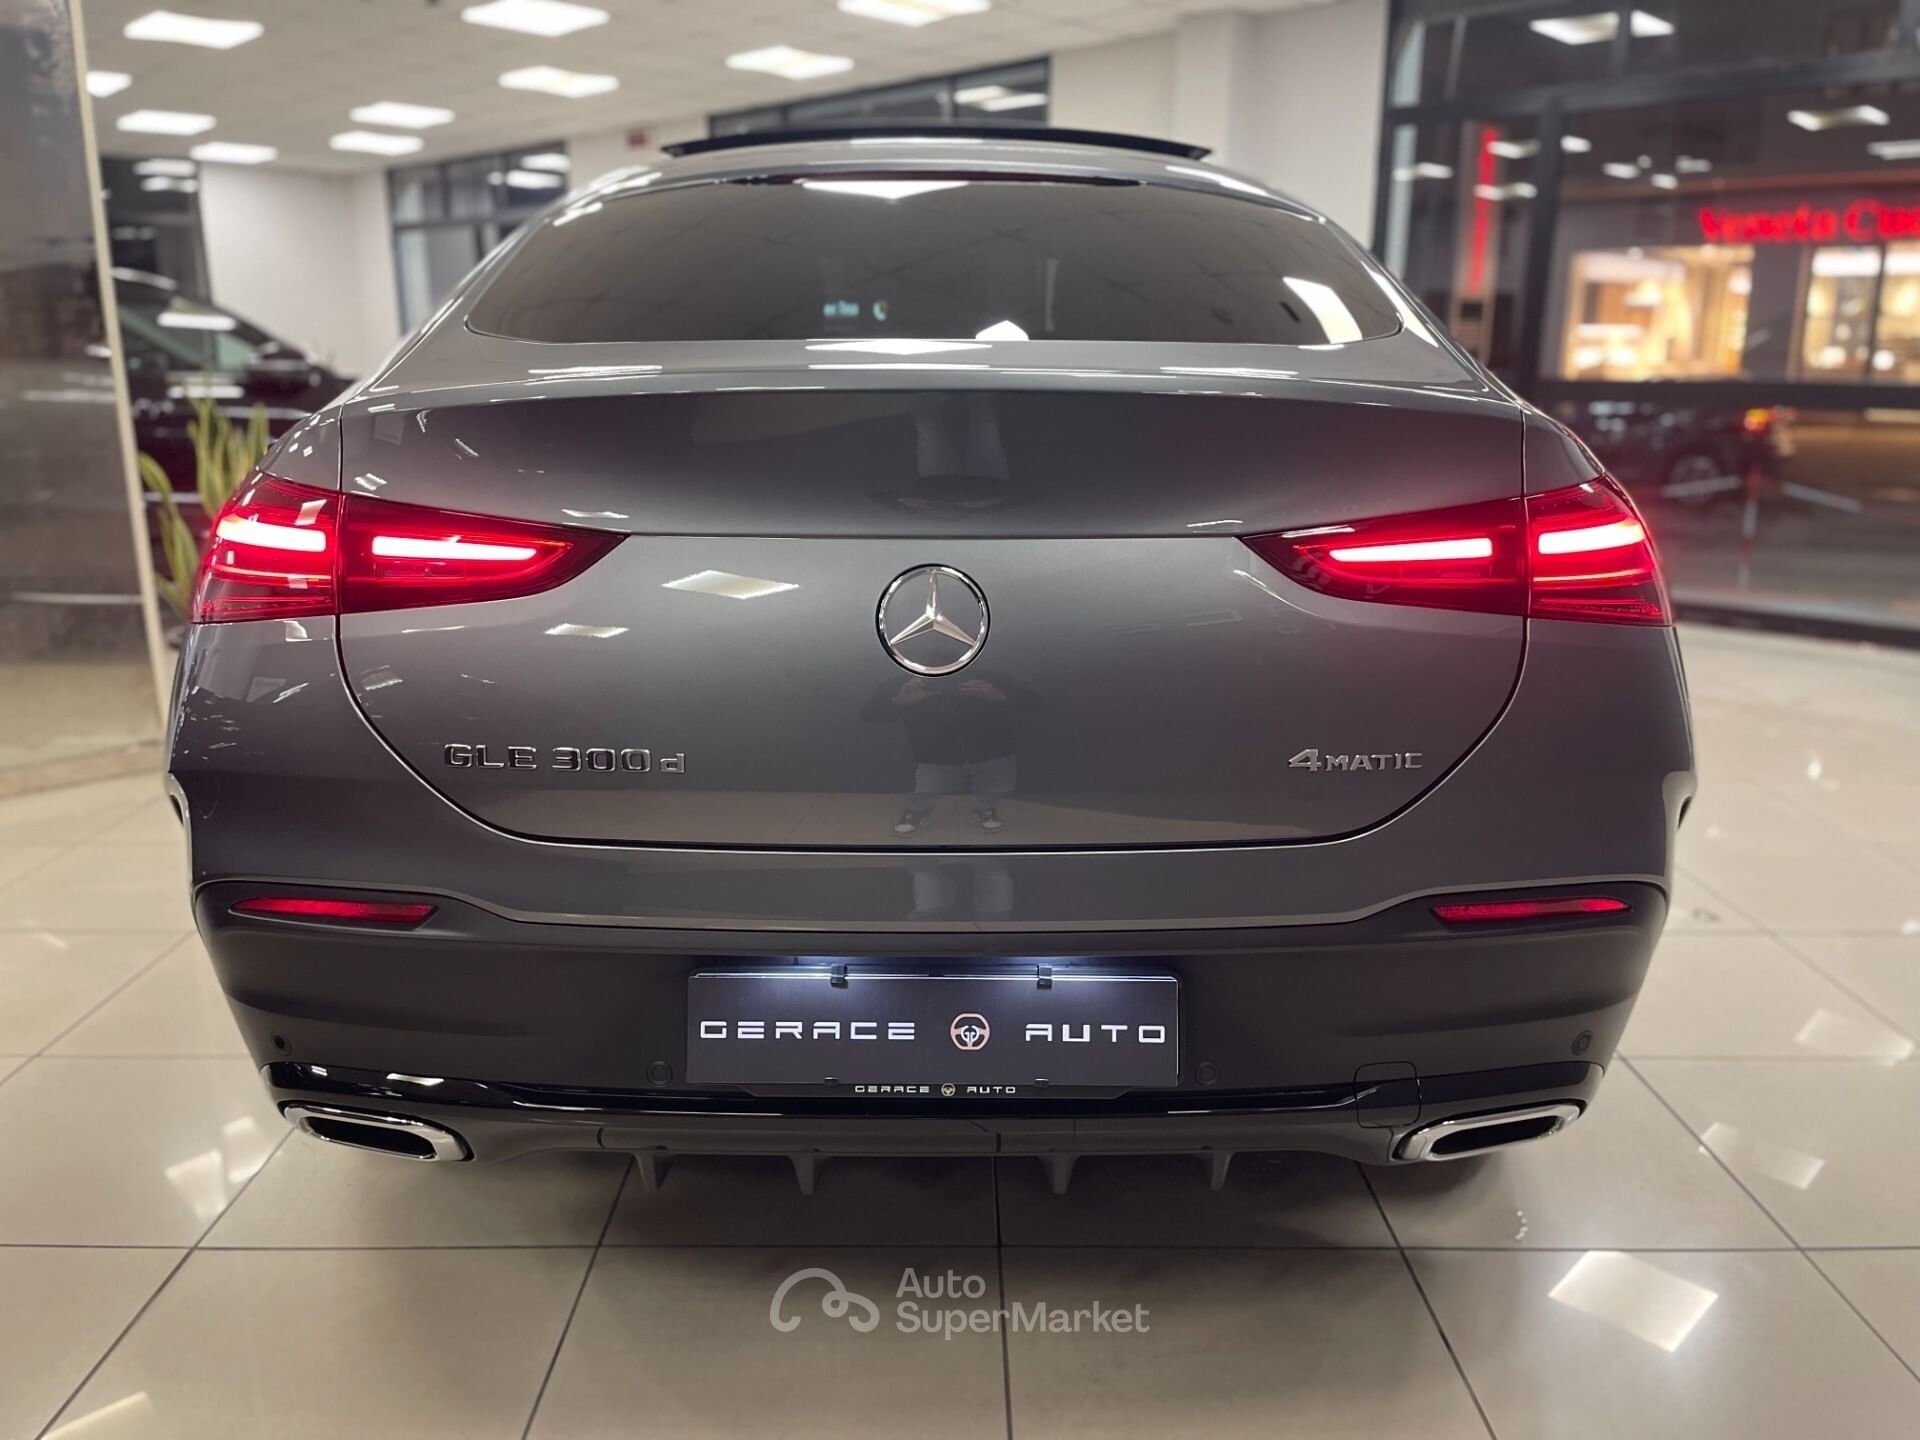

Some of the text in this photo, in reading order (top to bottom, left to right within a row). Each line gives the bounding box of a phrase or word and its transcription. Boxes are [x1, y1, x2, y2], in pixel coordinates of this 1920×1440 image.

[444, 743, 537, 769] GLE
[1288, 748, 1424, 772] 4MATIC
[699, 1020, 1166, 1044] GERACE AUTO
[854, 1084, 1017, 1095] GERACE AUTO
